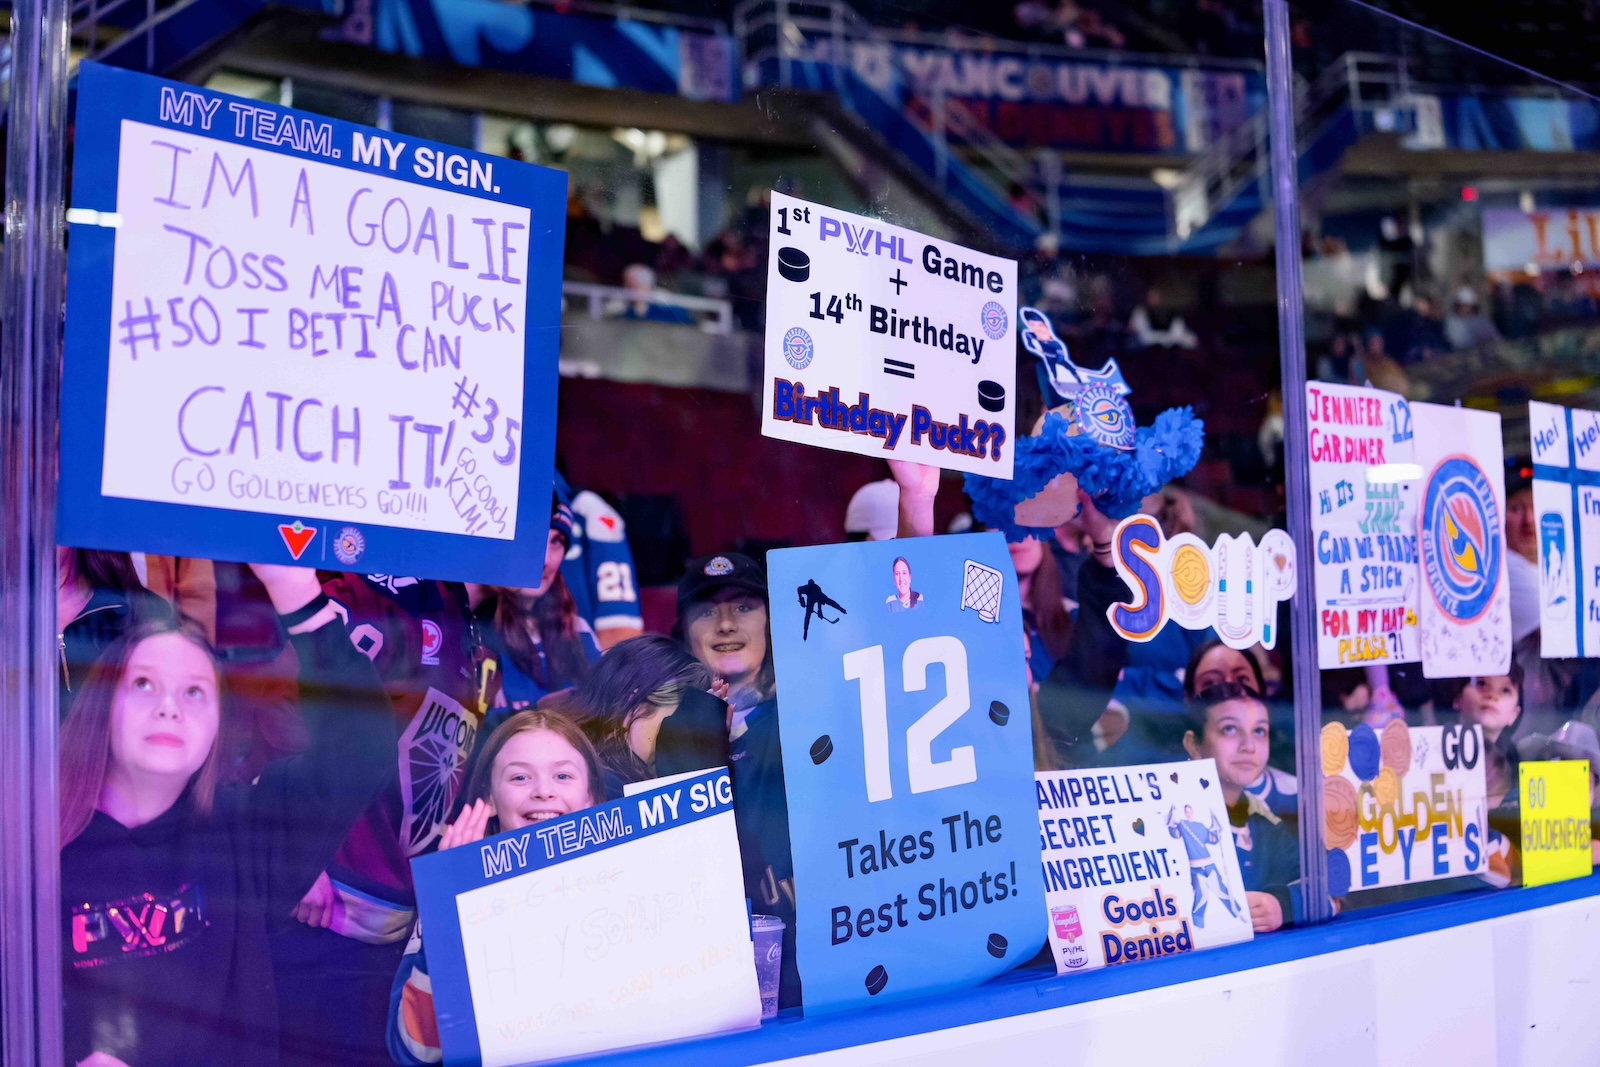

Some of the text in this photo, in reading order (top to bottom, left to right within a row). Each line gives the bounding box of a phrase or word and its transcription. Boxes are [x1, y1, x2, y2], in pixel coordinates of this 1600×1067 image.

[159, 86, 502, 195] MY TEAM. MY SIGN.
[290, 167, 315, 236] A
[346, 187, 526, 284] GOALIE
[777, 206, 1004, 294] 1st PWHL Game
[162, 223, 517, 334] TOSS ME A PUCK
[118, 294, 222, 361] #50
[236, 308, 269, 350] I
[289, 307, 348, 358] BET
[396, 323, 462, 374] CAN
[809, 291, 985, 365] 14th Birthday
[452, 376, 521, 467] #35
[773, 377, 1006, 462] Birthday Puck??
[1309, 388, 1383, 427] JENNIFER
[1389, 400, 1414, 444] 12
[178, 385, 457, 490] CATCH IT!
[457, 446, 477, 475] GO
[1309, 427, 1387, 464] GARDINER
[1533, 417, 1560, 458] Hei
[171, 456, 216, 495] GO
[227, 469, 368, 511] GOLDENEYES
[1317, 530, 1418, 565] CAN WE TRADE
[596, 560, 637, 603] 21
[1340, 564, 1402, 595] A STICK
[1321, 607, 1405, 638] FOR MY HAT
[843, 635, 978, 804] 12
[1441, 722, 1479, 771] GO
[1035, 772, 1162, 811] AMPBELL'S
[1356, 773, 1464, 855] GOLDEN
[1528, 777, 1546, 809] GO
[481, 775, 734, 878] MY TEAM. MY SIG
[838, 810, 1003, 879] Takes The
[1523, 816, 1592, 853] GOLDENEYES
[1041, 848, 1180, 893] INGREDIENT:
[831, 861, 1019, 946] Best Shots!
[1102, 887, 1178, 926] Goals
[1101, 919, 1193, 964] Denied
